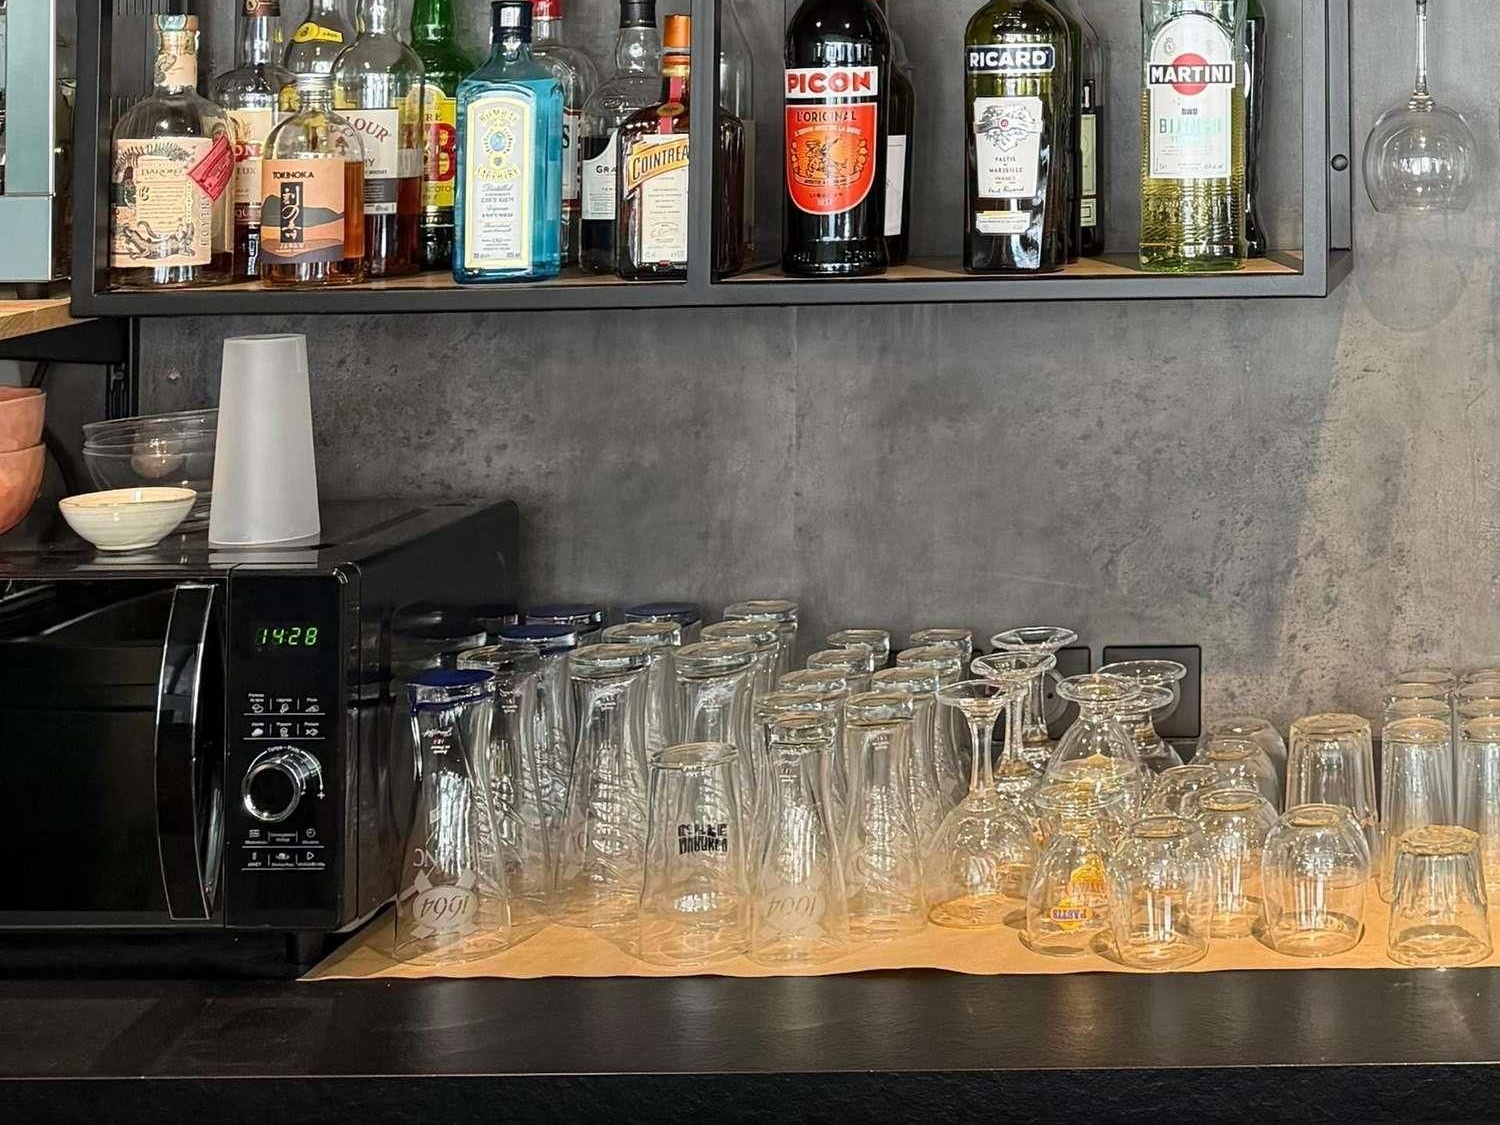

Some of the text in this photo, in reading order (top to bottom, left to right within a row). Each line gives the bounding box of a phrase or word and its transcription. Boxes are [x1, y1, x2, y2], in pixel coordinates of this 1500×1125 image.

[969, 49, 1048, 68] RICARD
[787, 71, 872, 94] PICON
[1150, 65, 1231, 83] MARTINI
[632, 144, 689, 182] COINTREA
[272, 171, 314, 179] TOKINOKA
[419, 894, 470, 917] 1664
